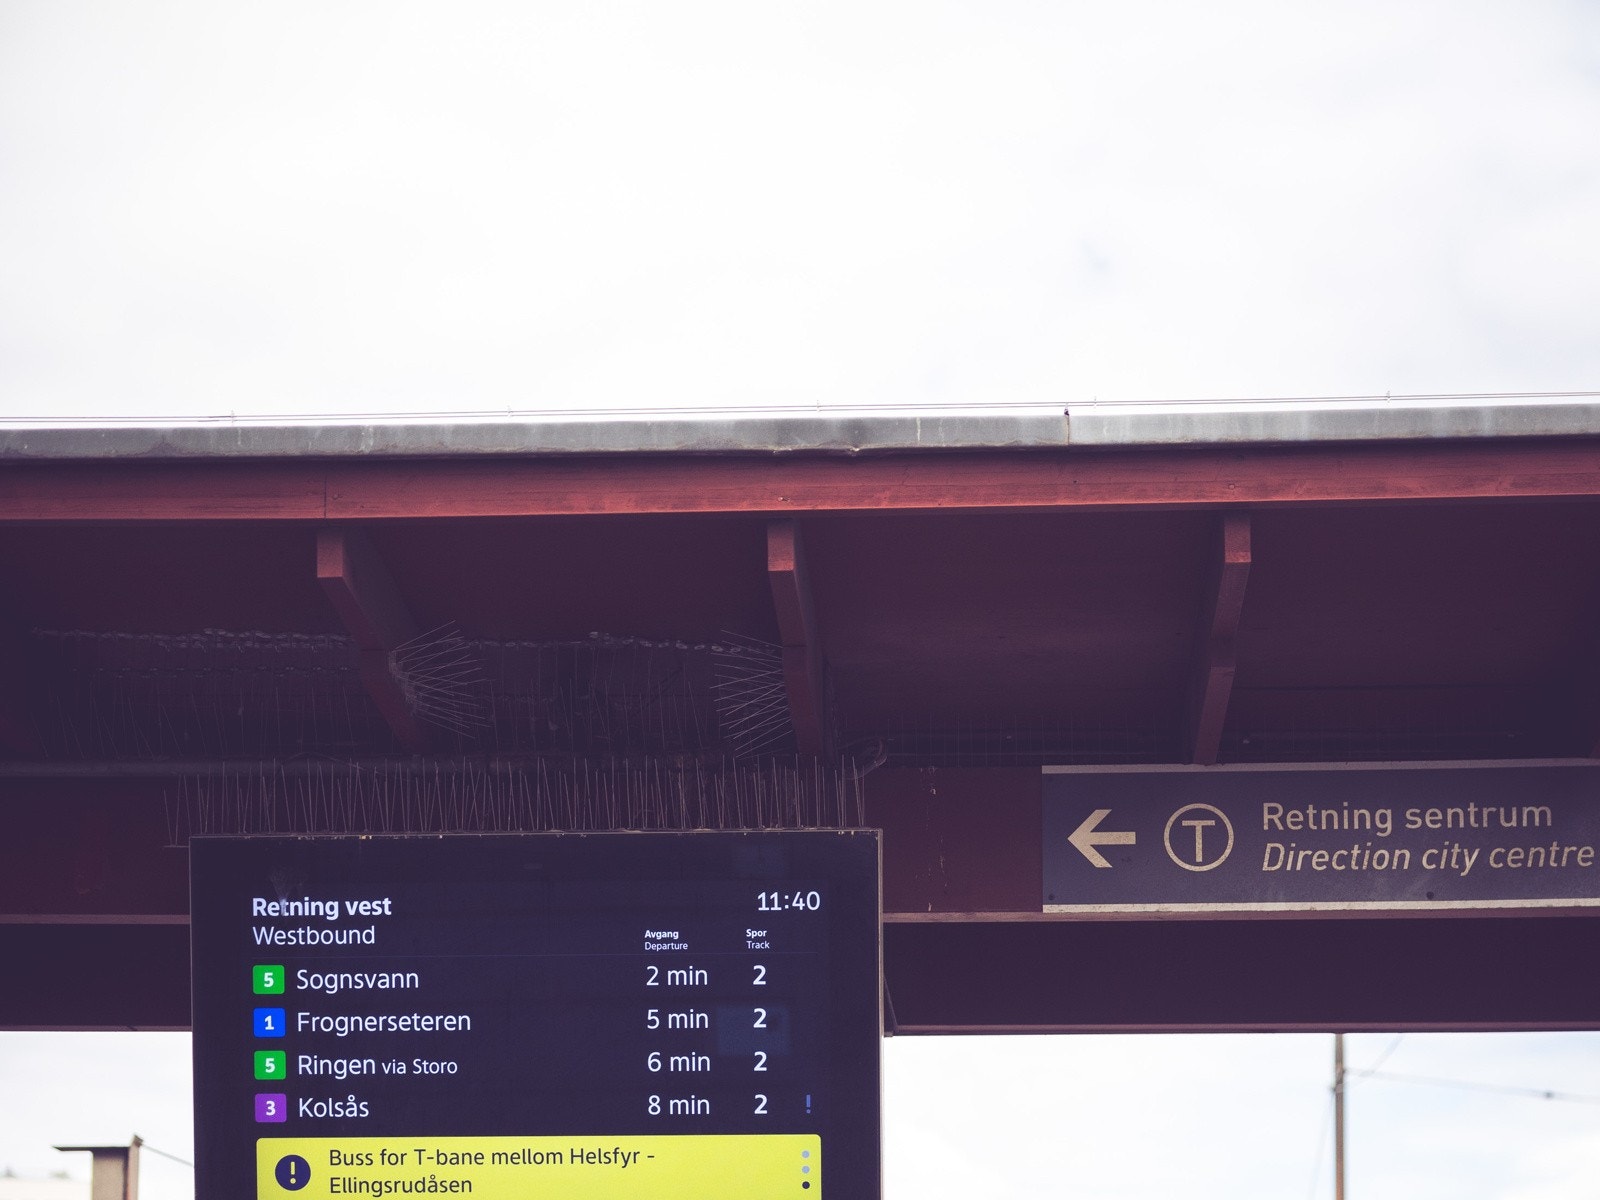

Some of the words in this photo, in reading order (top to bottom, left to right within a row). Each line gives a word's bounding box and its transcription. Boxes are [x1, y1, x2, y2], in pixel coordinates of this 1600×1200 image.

[1262, 802, 1393, 838] Retning
[1404, 802, 1553, 829] sentrum
[1262, 841, 1411, 872] Direction
[1422, 841, 1480, 877] city
[1488, 841, 1596, 869] centre
[252, 896, 339, 922] Retning
[345, 897, 392, 917] vest
[757, 890, 821, 912] 11:40
[252, 925, 376, 946] Westbound
[644, 929, 680, 941] Avgang
[746, 928, 768, 941] Spor
[746, 939, 770, 951] Track
[644, 940, 689, 952] Departure
[263, 972, 275, 988] 5
[296, 968, 420, 994] Sognsvann
[646, 965, 660, 986] 2
[667, 965, 709, 987] min
[752, 964, 767, 986] 2
[264, 1015, 275, 1031] 1
[297, 1011, 472, 1037] Frognerseteren
[647, 1008, 660, 1030] 5
[668, 1008, 710, 1030] min
[753, 1007, 767, 1029] 2
[264, 1057, 276, 1074] 5
[298, 1054, 376, 1080] Ringen
[381, 1057, 407, 1076] via
[412, 1057, 459, 1076] Storo
[647, 1051, 662, 1073] 6
[670, 1051, 711, 1072] min
[753, 1050, 768, 1072] 2
[265, 1100, 277, 1117] 3
[298, 1093, 370, 1119] Kolsås
[647, 1094, 662, 1116] 8
[669, 1094, 711, 1115] min
[754, 1093, 768, 1115] 2
[329, 1149, 375, 1167] Buss
[379, 1147, 409, 1166] for
[413, 1148, 485, 1167] T-bane
[491, 1148, 564, 1167] mellom
[570, 1146, 641, 1170] Helsfyr
[330, 1174, 473, 1198] Ellingsrudåsen
